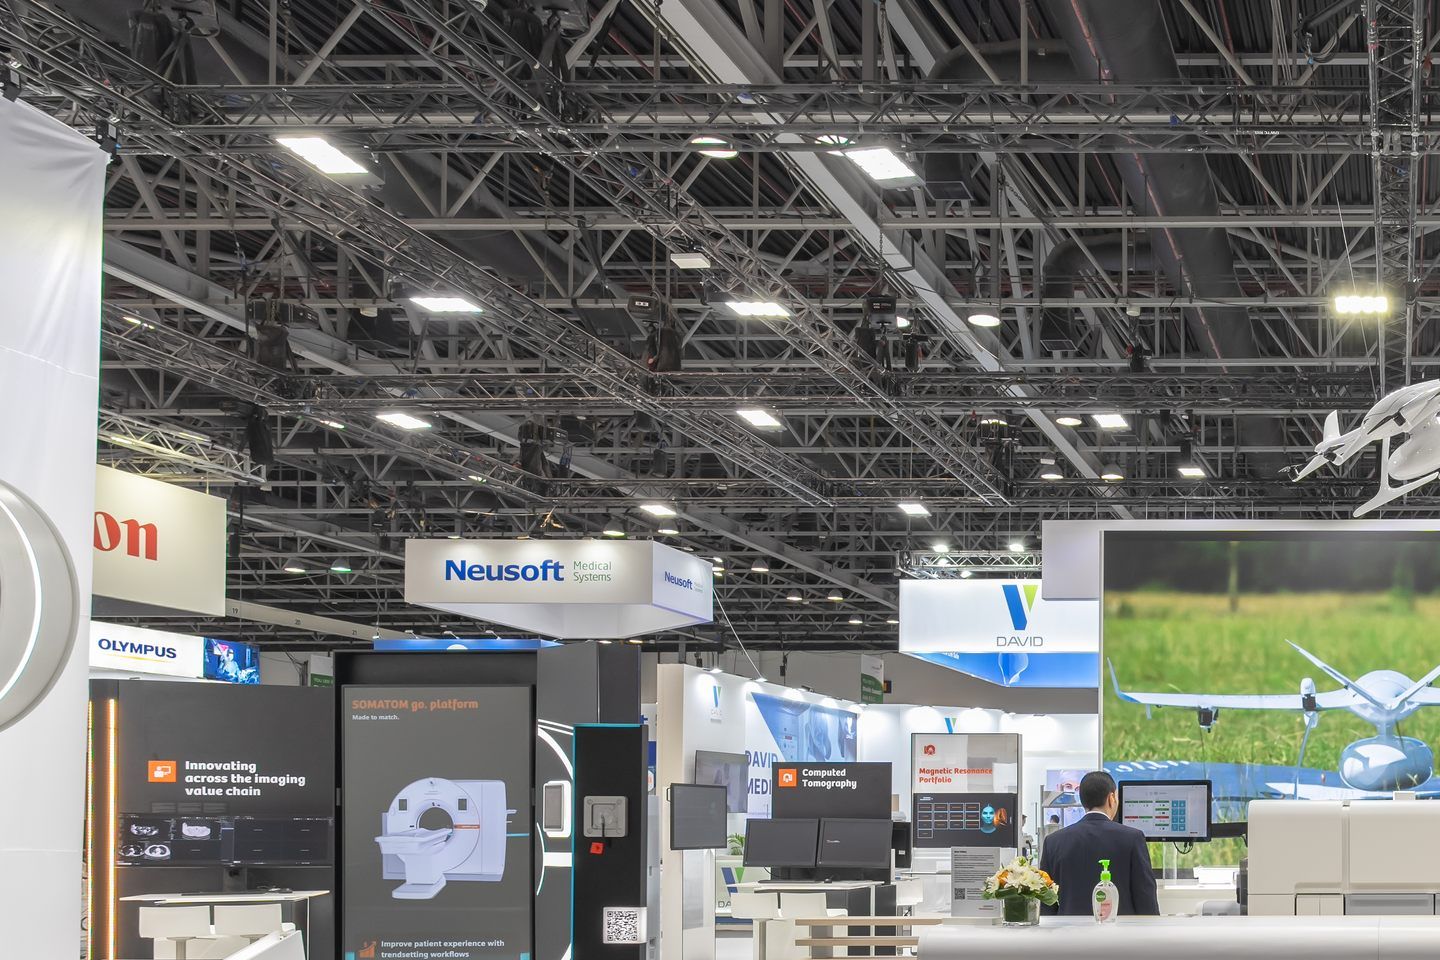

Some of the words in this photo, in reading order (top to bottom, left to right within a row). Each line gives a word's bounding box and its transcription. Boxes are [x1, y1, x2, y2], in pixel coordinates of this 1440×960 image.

[445, 559, 564, 582] Neusoft
[573, 560, 612, 571] Medical
[573, 571, 612, 583] Systems
[664, 571, 693, 591] Neusoft
[996, 636, 1043, 647] DAVID
[98, 638, 177, 659] OLYMPUS
[352, 699, 408, 710] SOMATOM
[411, 701, 427, 712] go.
[430, 699, 479, 712] platform
[745, 750, 778, 768] DAVID
[185, 761, 257, 773] Innovating
[919, 767, 952, 776] Magnetic
[954, 767, 993, 775] Resonance
[802, 768, 846, 779] Computed
[185, 775, 228, 784] across
[230, 774, 252, 784] the
[254, 774, 306, 786] imaging
[802, 779, 857, 790] Tomography
[919, 776, 952, 785] Portfolio
[185, 786, 223, 796] value
[225, 786, 261, 796] chain
[381, 941, 413, 949] Improve
[414, 940, 442, 949] patient
[443, 940, 486, 949] experience
[381, 951, 429, 960] trendsetting
